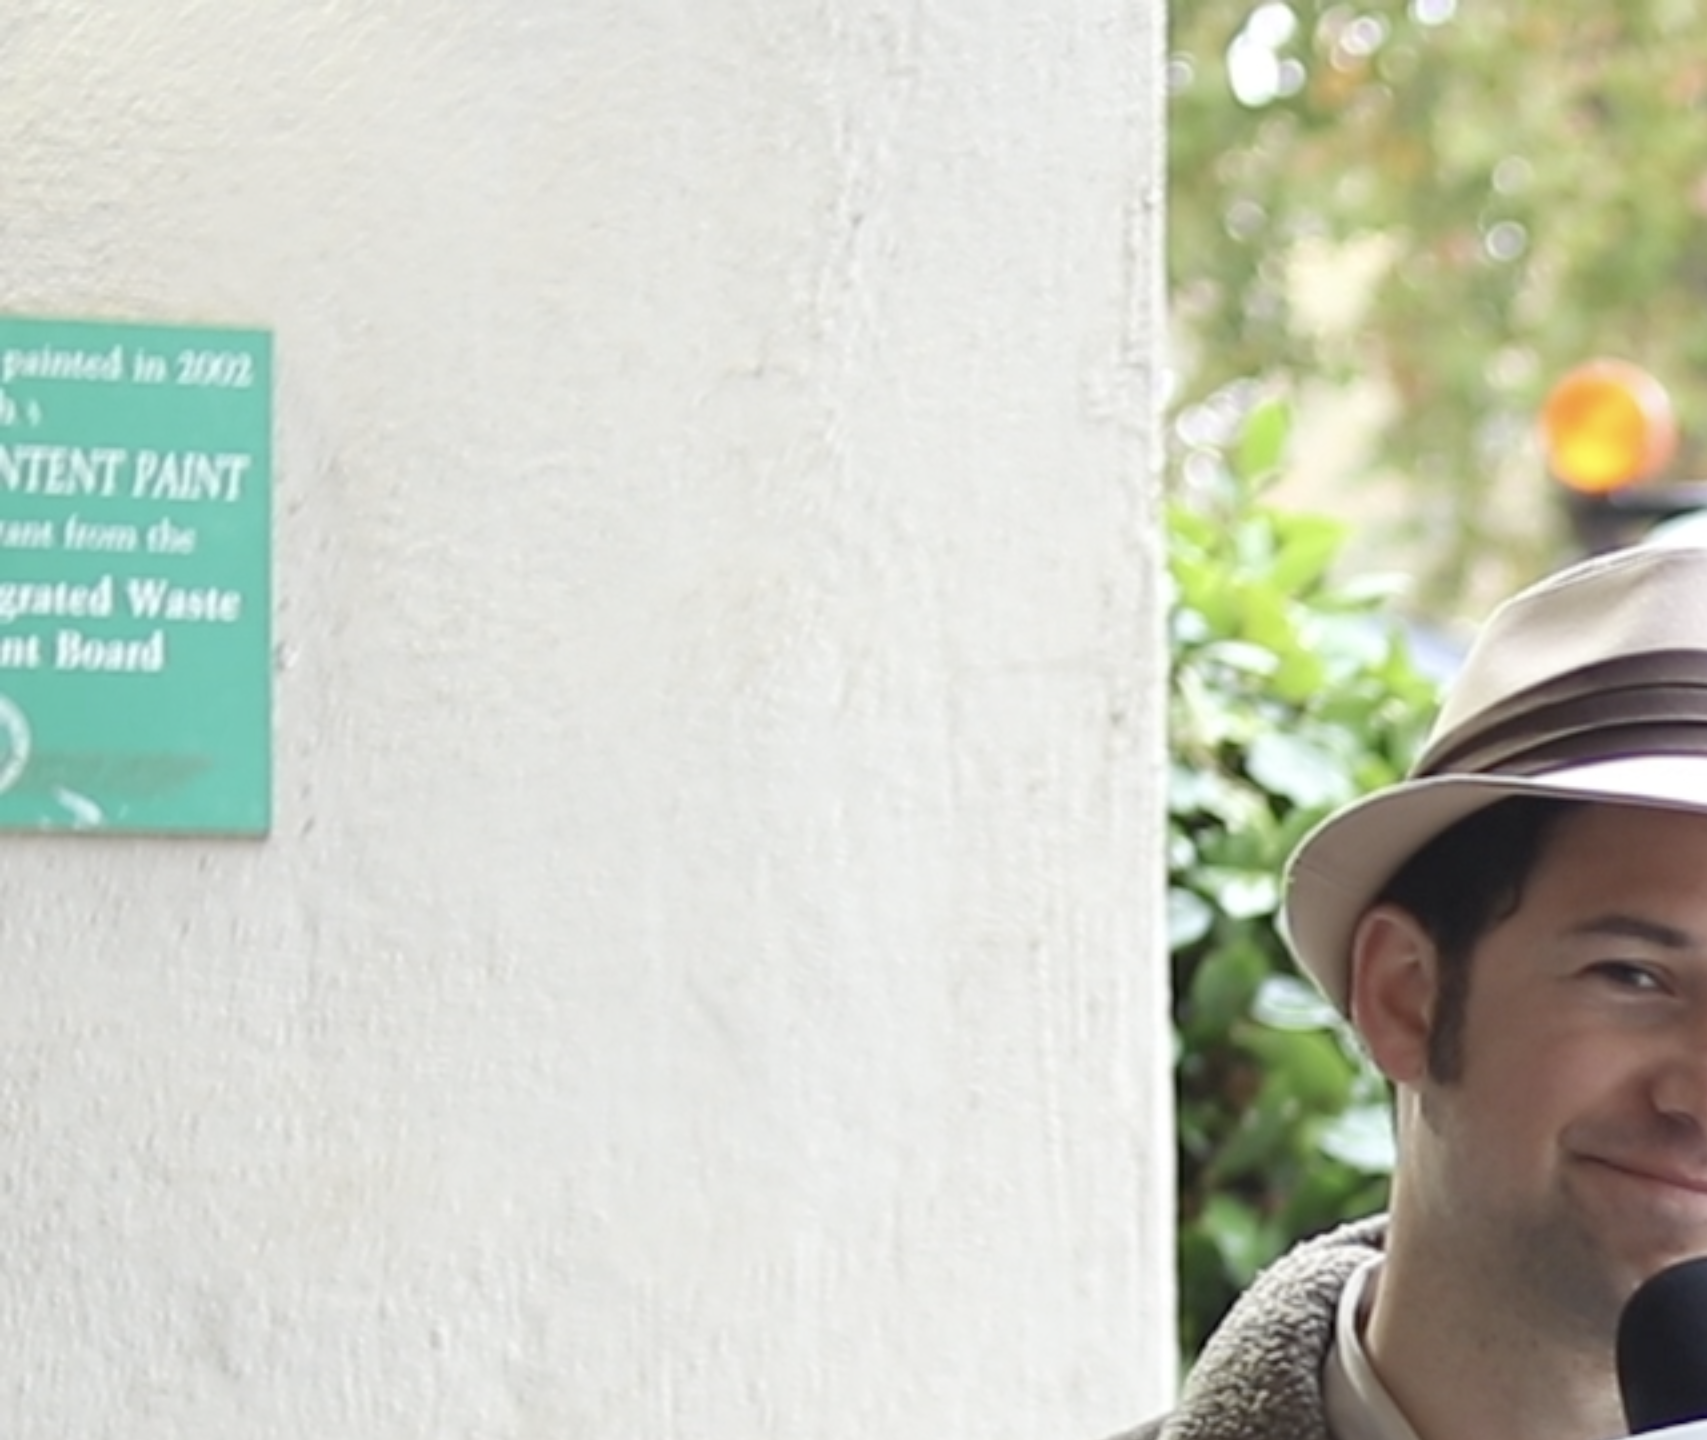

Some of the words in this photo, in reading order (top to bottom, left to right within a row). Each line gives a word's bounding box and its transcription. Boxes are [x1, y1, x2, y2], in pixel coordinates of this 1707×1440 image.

[3, 343, 122, 384] painted
[134, 348, 165, 383] in
[177, 350, 252, 387] 2002
[132, 450, 250, 502] PAINT
[0, 518, 53, 549] ant
[64, 513, 136, 552] from
[147, 518, 195, 554] the
[0, 574, 112, 624] grated
[127, 577, 240, 621] Waste
[55, 629, 164, 672] Board
